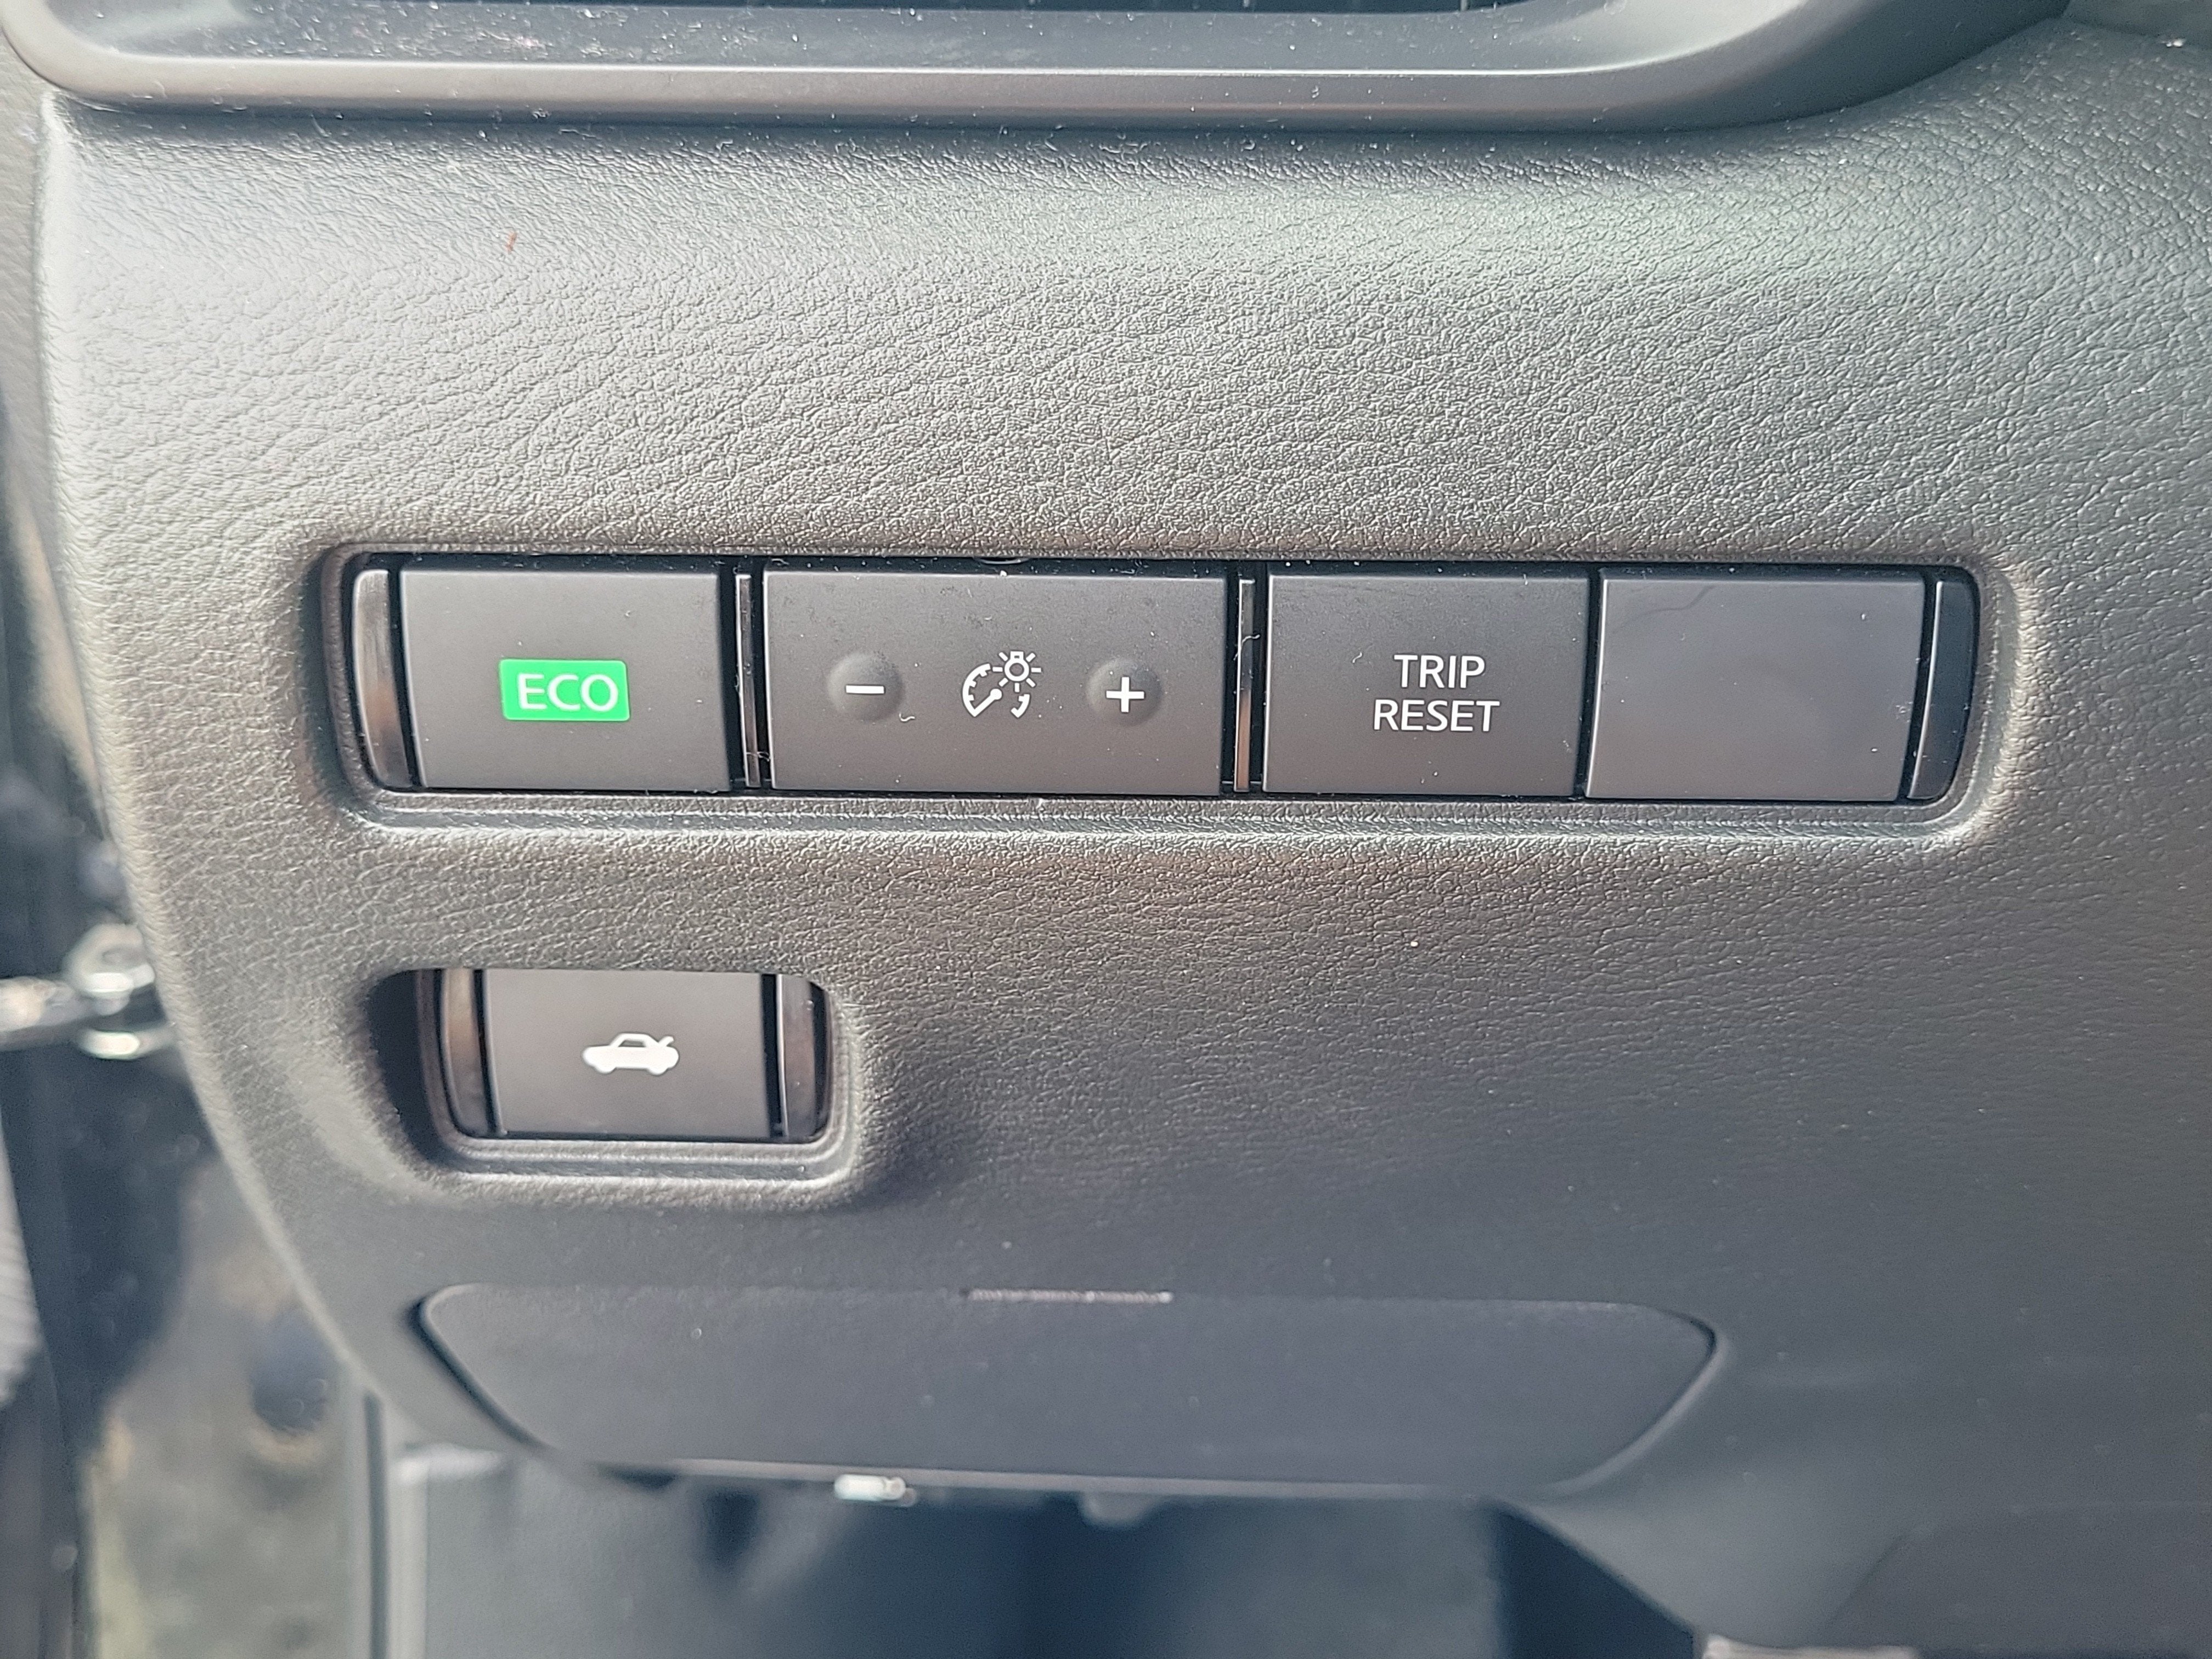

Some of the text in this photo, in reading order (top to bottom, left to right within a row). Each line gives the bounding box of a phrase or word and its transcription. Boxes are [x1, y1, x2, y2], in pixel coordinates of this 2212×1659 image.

[1393, 655, 1485, 688] TRIP
[518, 673, 618, 712] ECO
[1374, 699, 1500, 732] RESET
